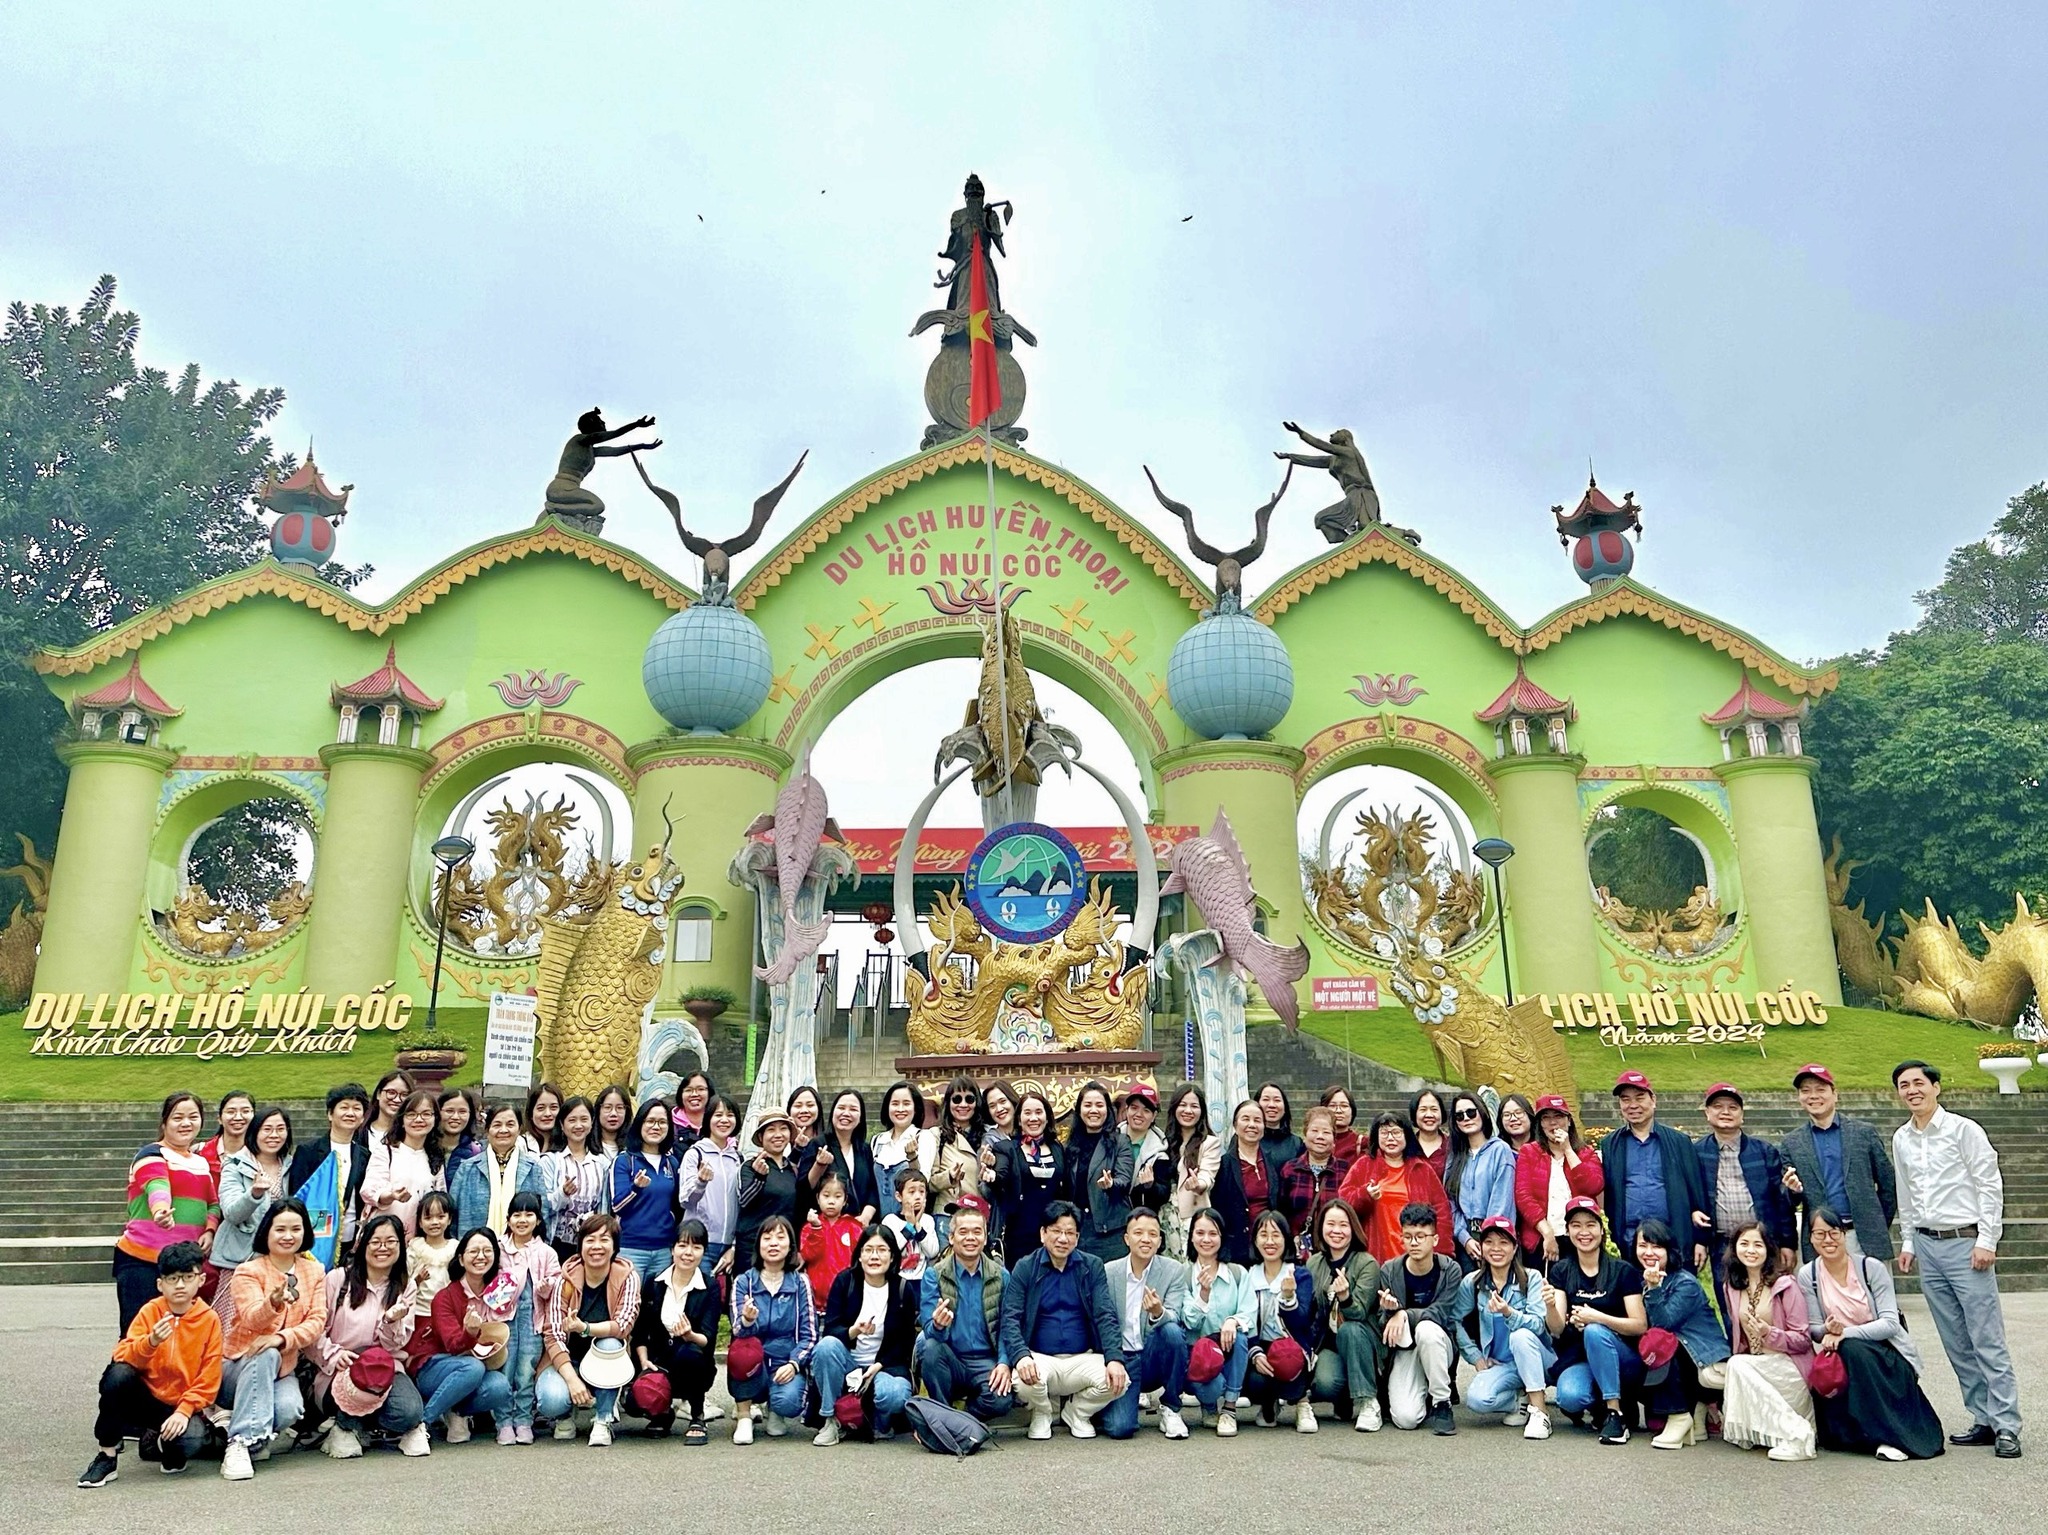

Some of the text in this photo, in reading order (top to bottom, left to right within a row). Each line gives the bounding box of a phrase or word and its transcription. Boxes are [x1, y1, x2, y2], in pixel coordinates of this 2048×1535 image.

[823, 546, 864, 586] DU
[865, 509, 938, 554] LỊCH
[1051, 527, 1131, 596] THOẠI
[888, 537, 1062, 578] HỒ NÚI CỐC
[820, 839, 883, 860] húc
[1109, 841, 1173, 860] 22
[23, 992, 85, 1030] DU
[188, 981, 250, 1030] HỒ
[252, 986, 326, 1030] NÚI
[333, 980, 413, 1030] CỐC
[1628, 983, 1679, 1027] HỒ
[1685, 984, 1752, 1026] NÚI
[1756, 979, 1828, 1025] CỐC
[29, 1028, 106, 1054] Kính
[112, 1029, 186, 1055] Chào
[264, 1026, 358, 1053] Khách
[1600, 1023, 1766, 1045] Năm 2024
